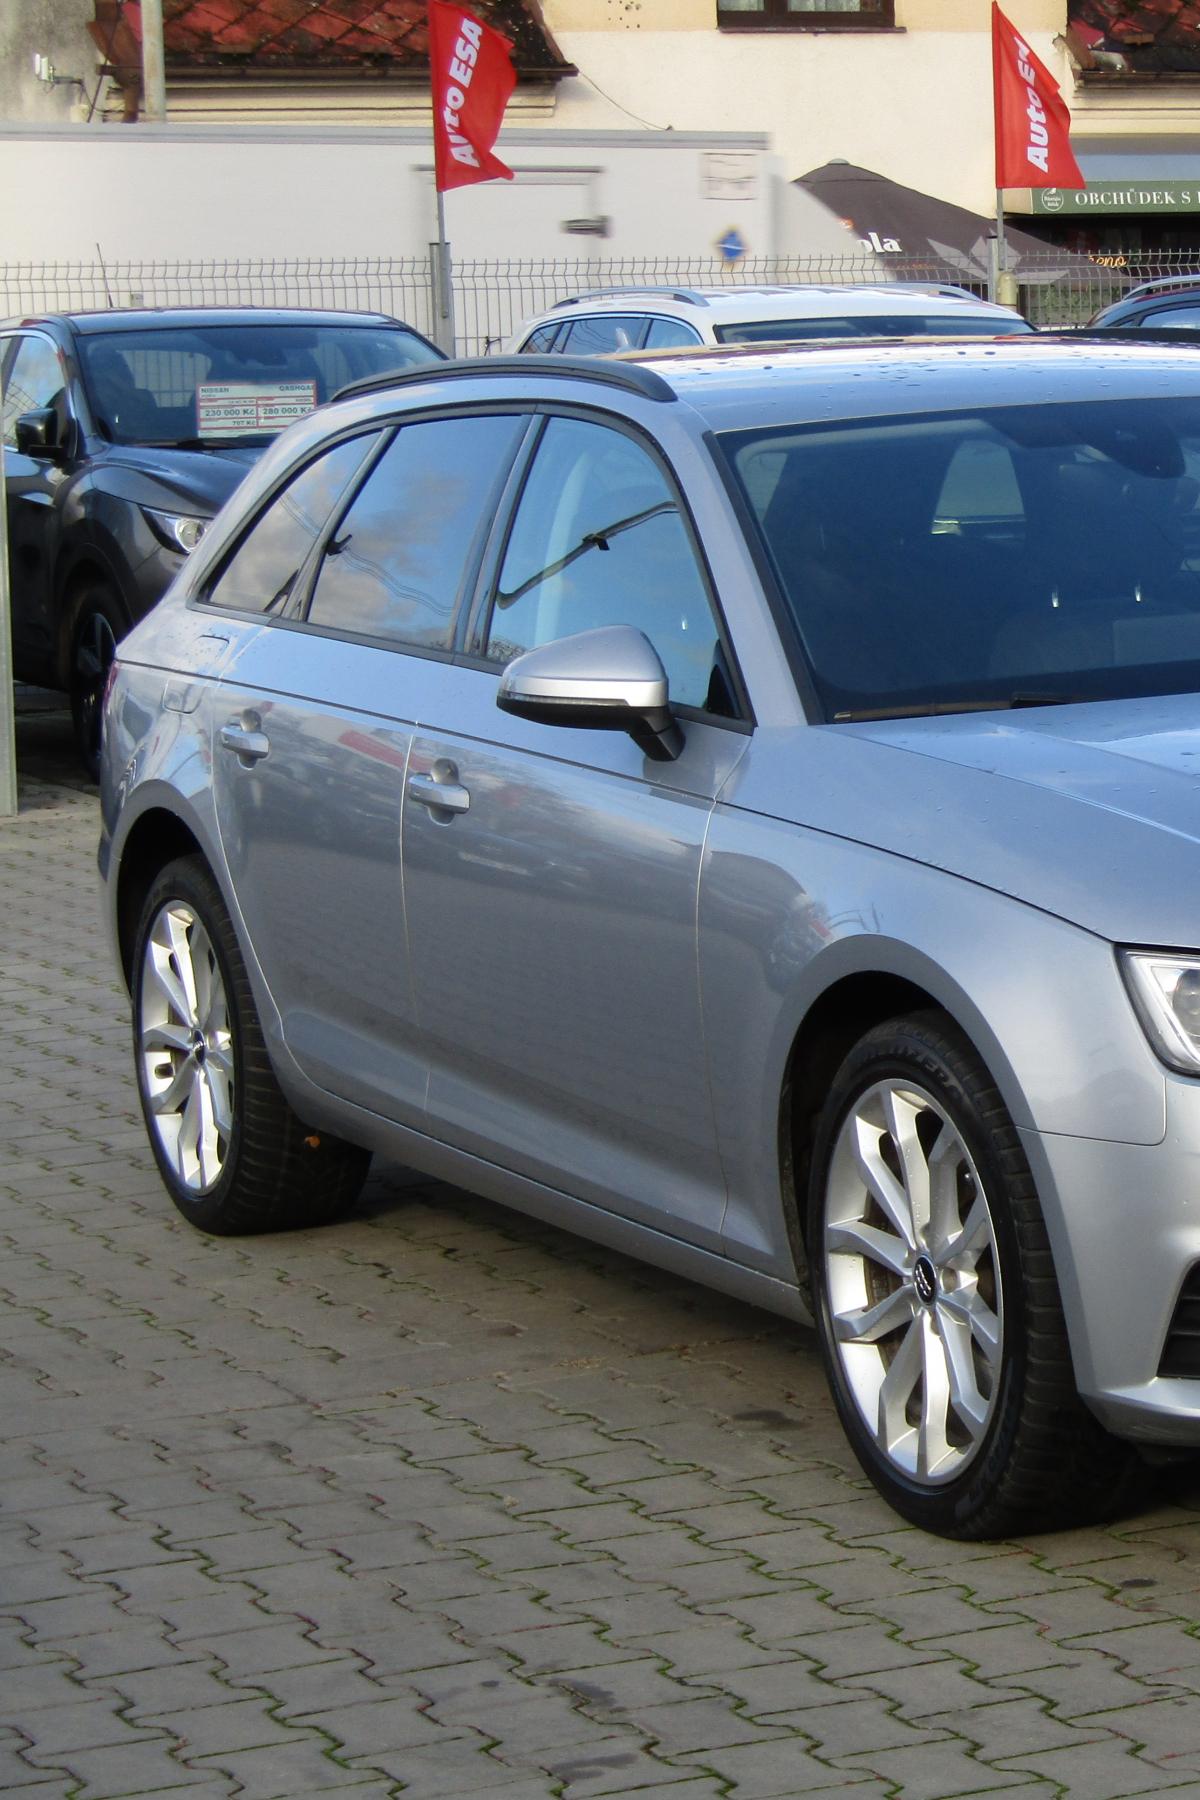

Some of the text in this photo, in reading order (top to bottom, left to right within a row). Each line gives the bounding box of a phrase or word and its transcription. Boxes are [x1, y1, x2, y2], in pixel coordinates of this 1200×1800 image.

[449, 18, 483, 88] ESA
[1026, 88, 1049, 173] Auto
[1075, 188, 1176, 206] OBCHŮDEK
[1181, 191, 1191, 204] S
[205, 409, 222, 417] 230
[223, 408, 241, 416] 000
[262, 407, 279, 415] 280
[281, 406, 298, 414] 000
